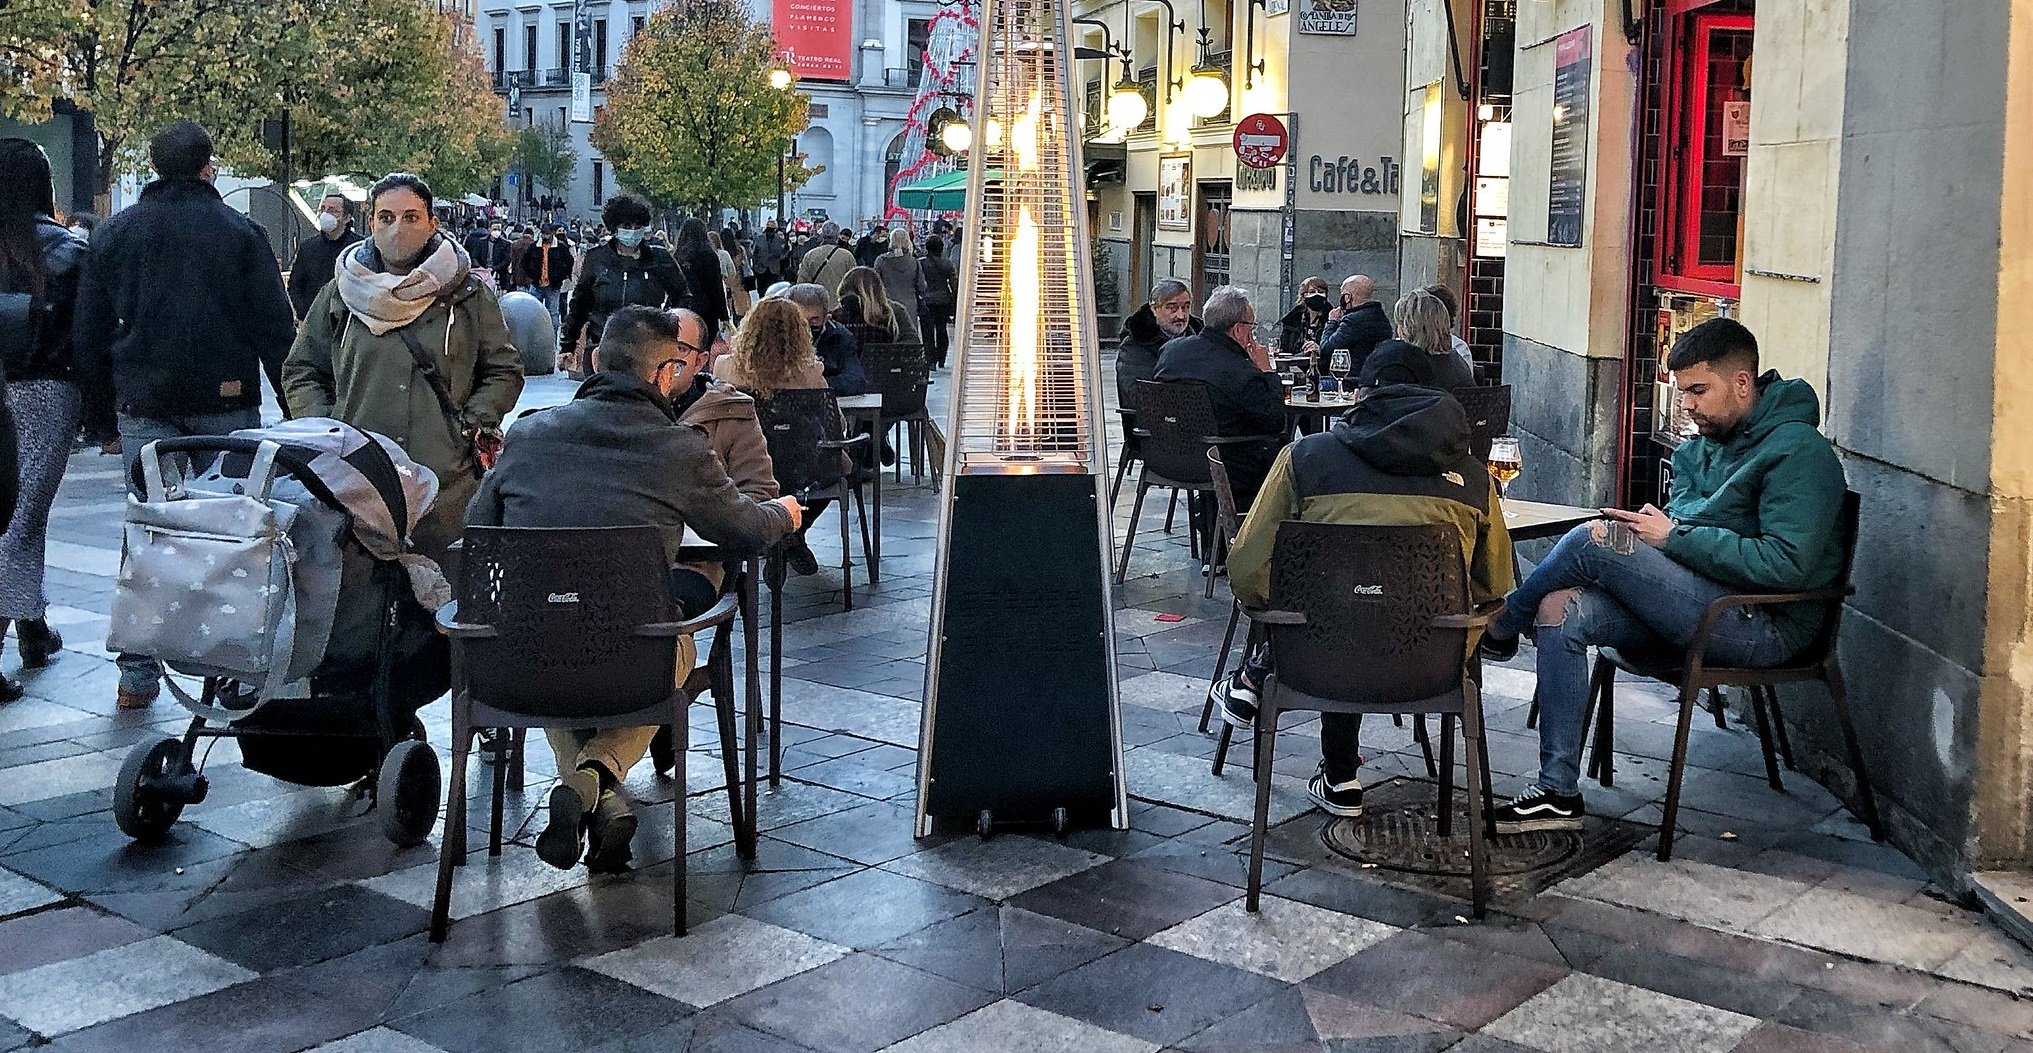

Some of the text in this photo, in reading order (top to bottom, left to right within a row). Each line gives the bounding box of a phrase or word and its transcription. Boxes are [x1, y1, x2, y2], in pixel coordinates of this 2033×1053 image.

[790, 4, 836, 12] CONCIERTOS
[789, 14, 836, 22] FLAMENCO
[1300, 21, 1354, 32] ANGELES
